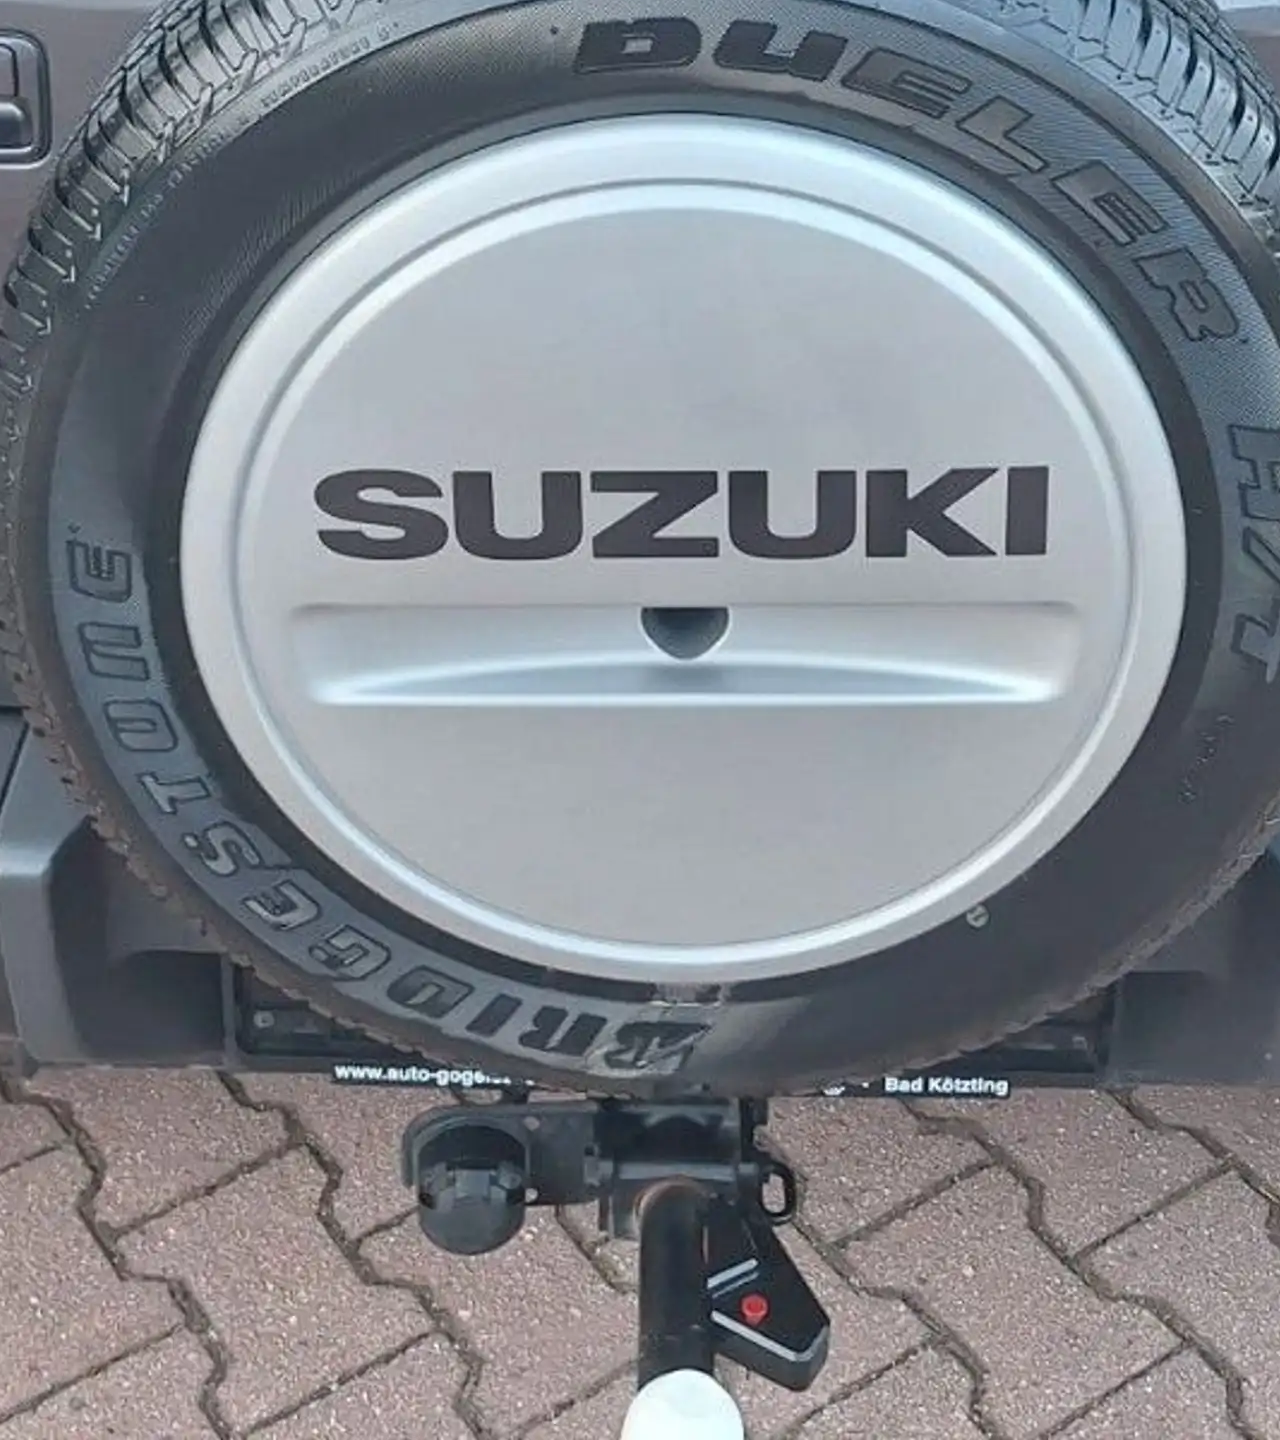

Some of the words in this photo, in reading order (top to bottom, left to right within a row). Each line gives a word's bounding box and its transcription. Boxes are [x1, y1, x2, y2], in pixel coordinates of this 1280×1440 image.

[572, 16, 1242, 345] DUELER
[314, 465, 1050, 561] SUZUKI
[68, 538, 716, 1080] BRIDGESTONE
[884, 1076, 923, 1094] Bad
